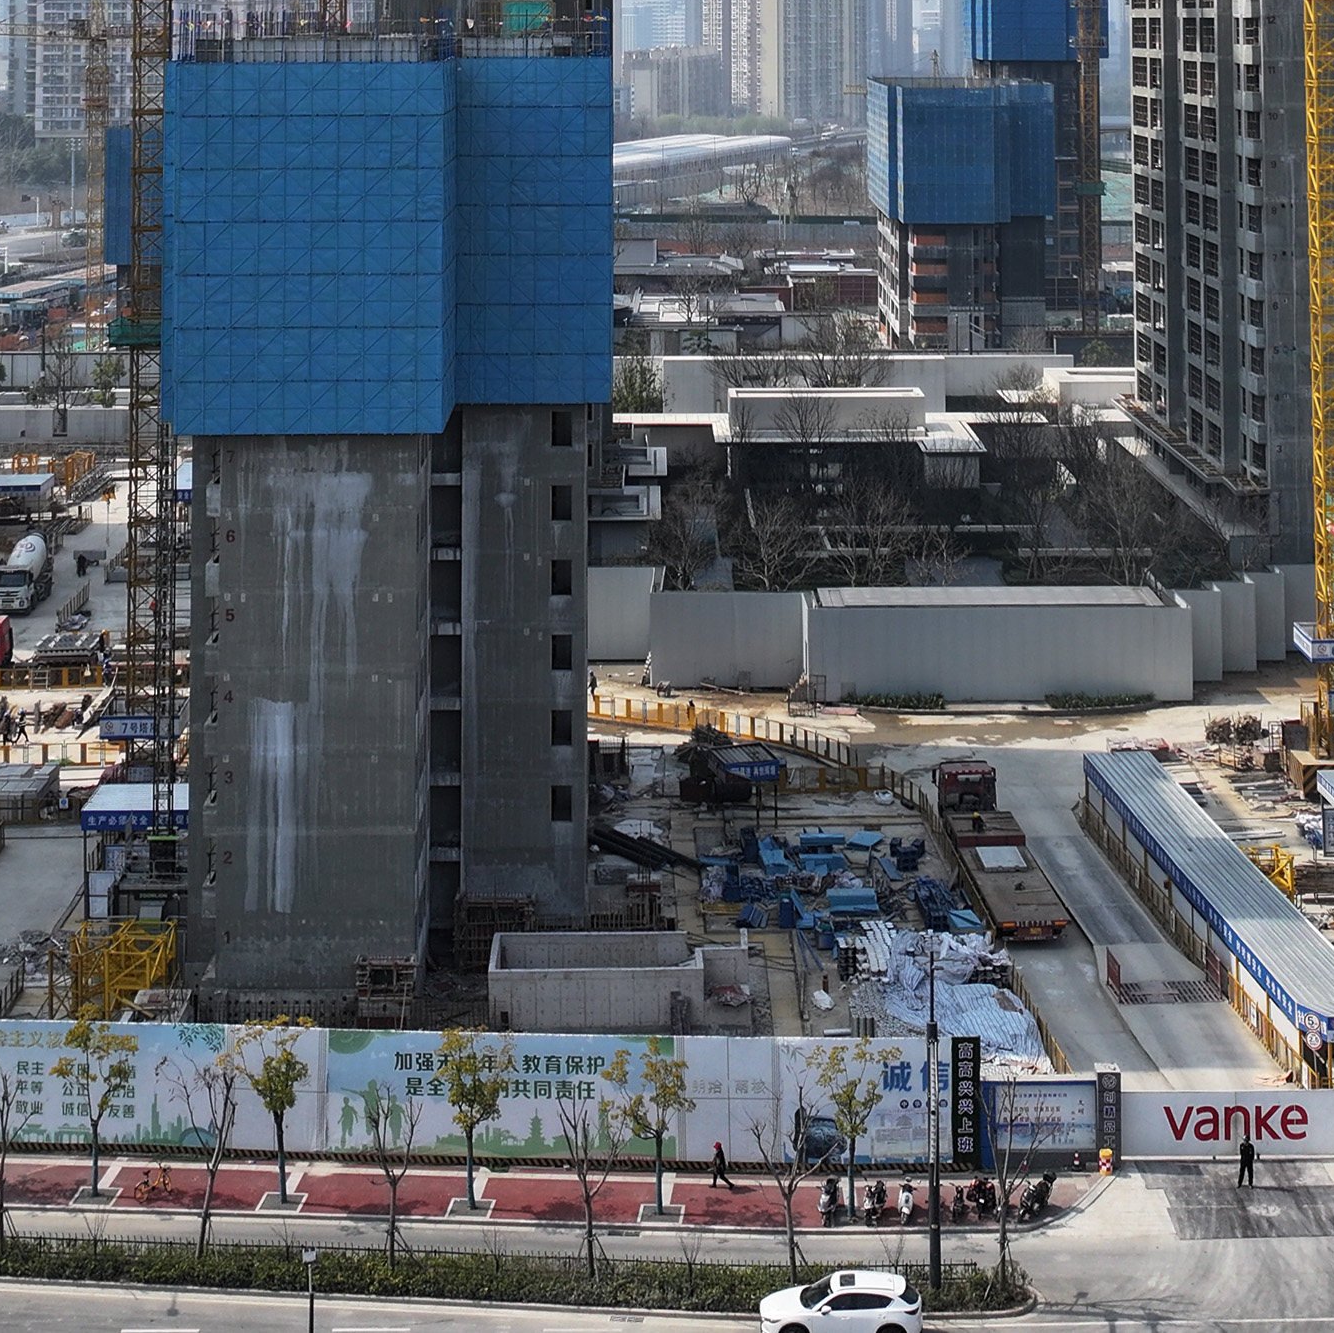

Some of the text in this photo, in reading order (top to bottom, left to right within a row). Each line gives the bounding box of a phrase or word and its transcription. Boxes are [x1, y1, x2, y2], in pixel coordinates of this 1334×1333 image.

[227, 450, 236, 464] 7
[226, 530, 236, 544] 6
[225, 609, 236, 623] 5
[223, 691, 234, 705] 4
[224, 772, 234, 785] 3
[223, 852, 233, 865] 2
[224, 932, 231, 945] 1
[17, 1060, 44, 1076] 民主
[882, 1061, 951, 1093] 诚信
[17, 1080, 44, 1095] 平等
[405, 1077, 595, 1100] 是全的共同责任
[957, 1041, 974, 1153] 高高兴兴上班
[17, 1100, 44, 1115] 敬业
[62, 1101, 90, 1118] 诚信
[108, 1103, 136, 1119] 友善
[1163, 1104, 1309, 1142] vanke
